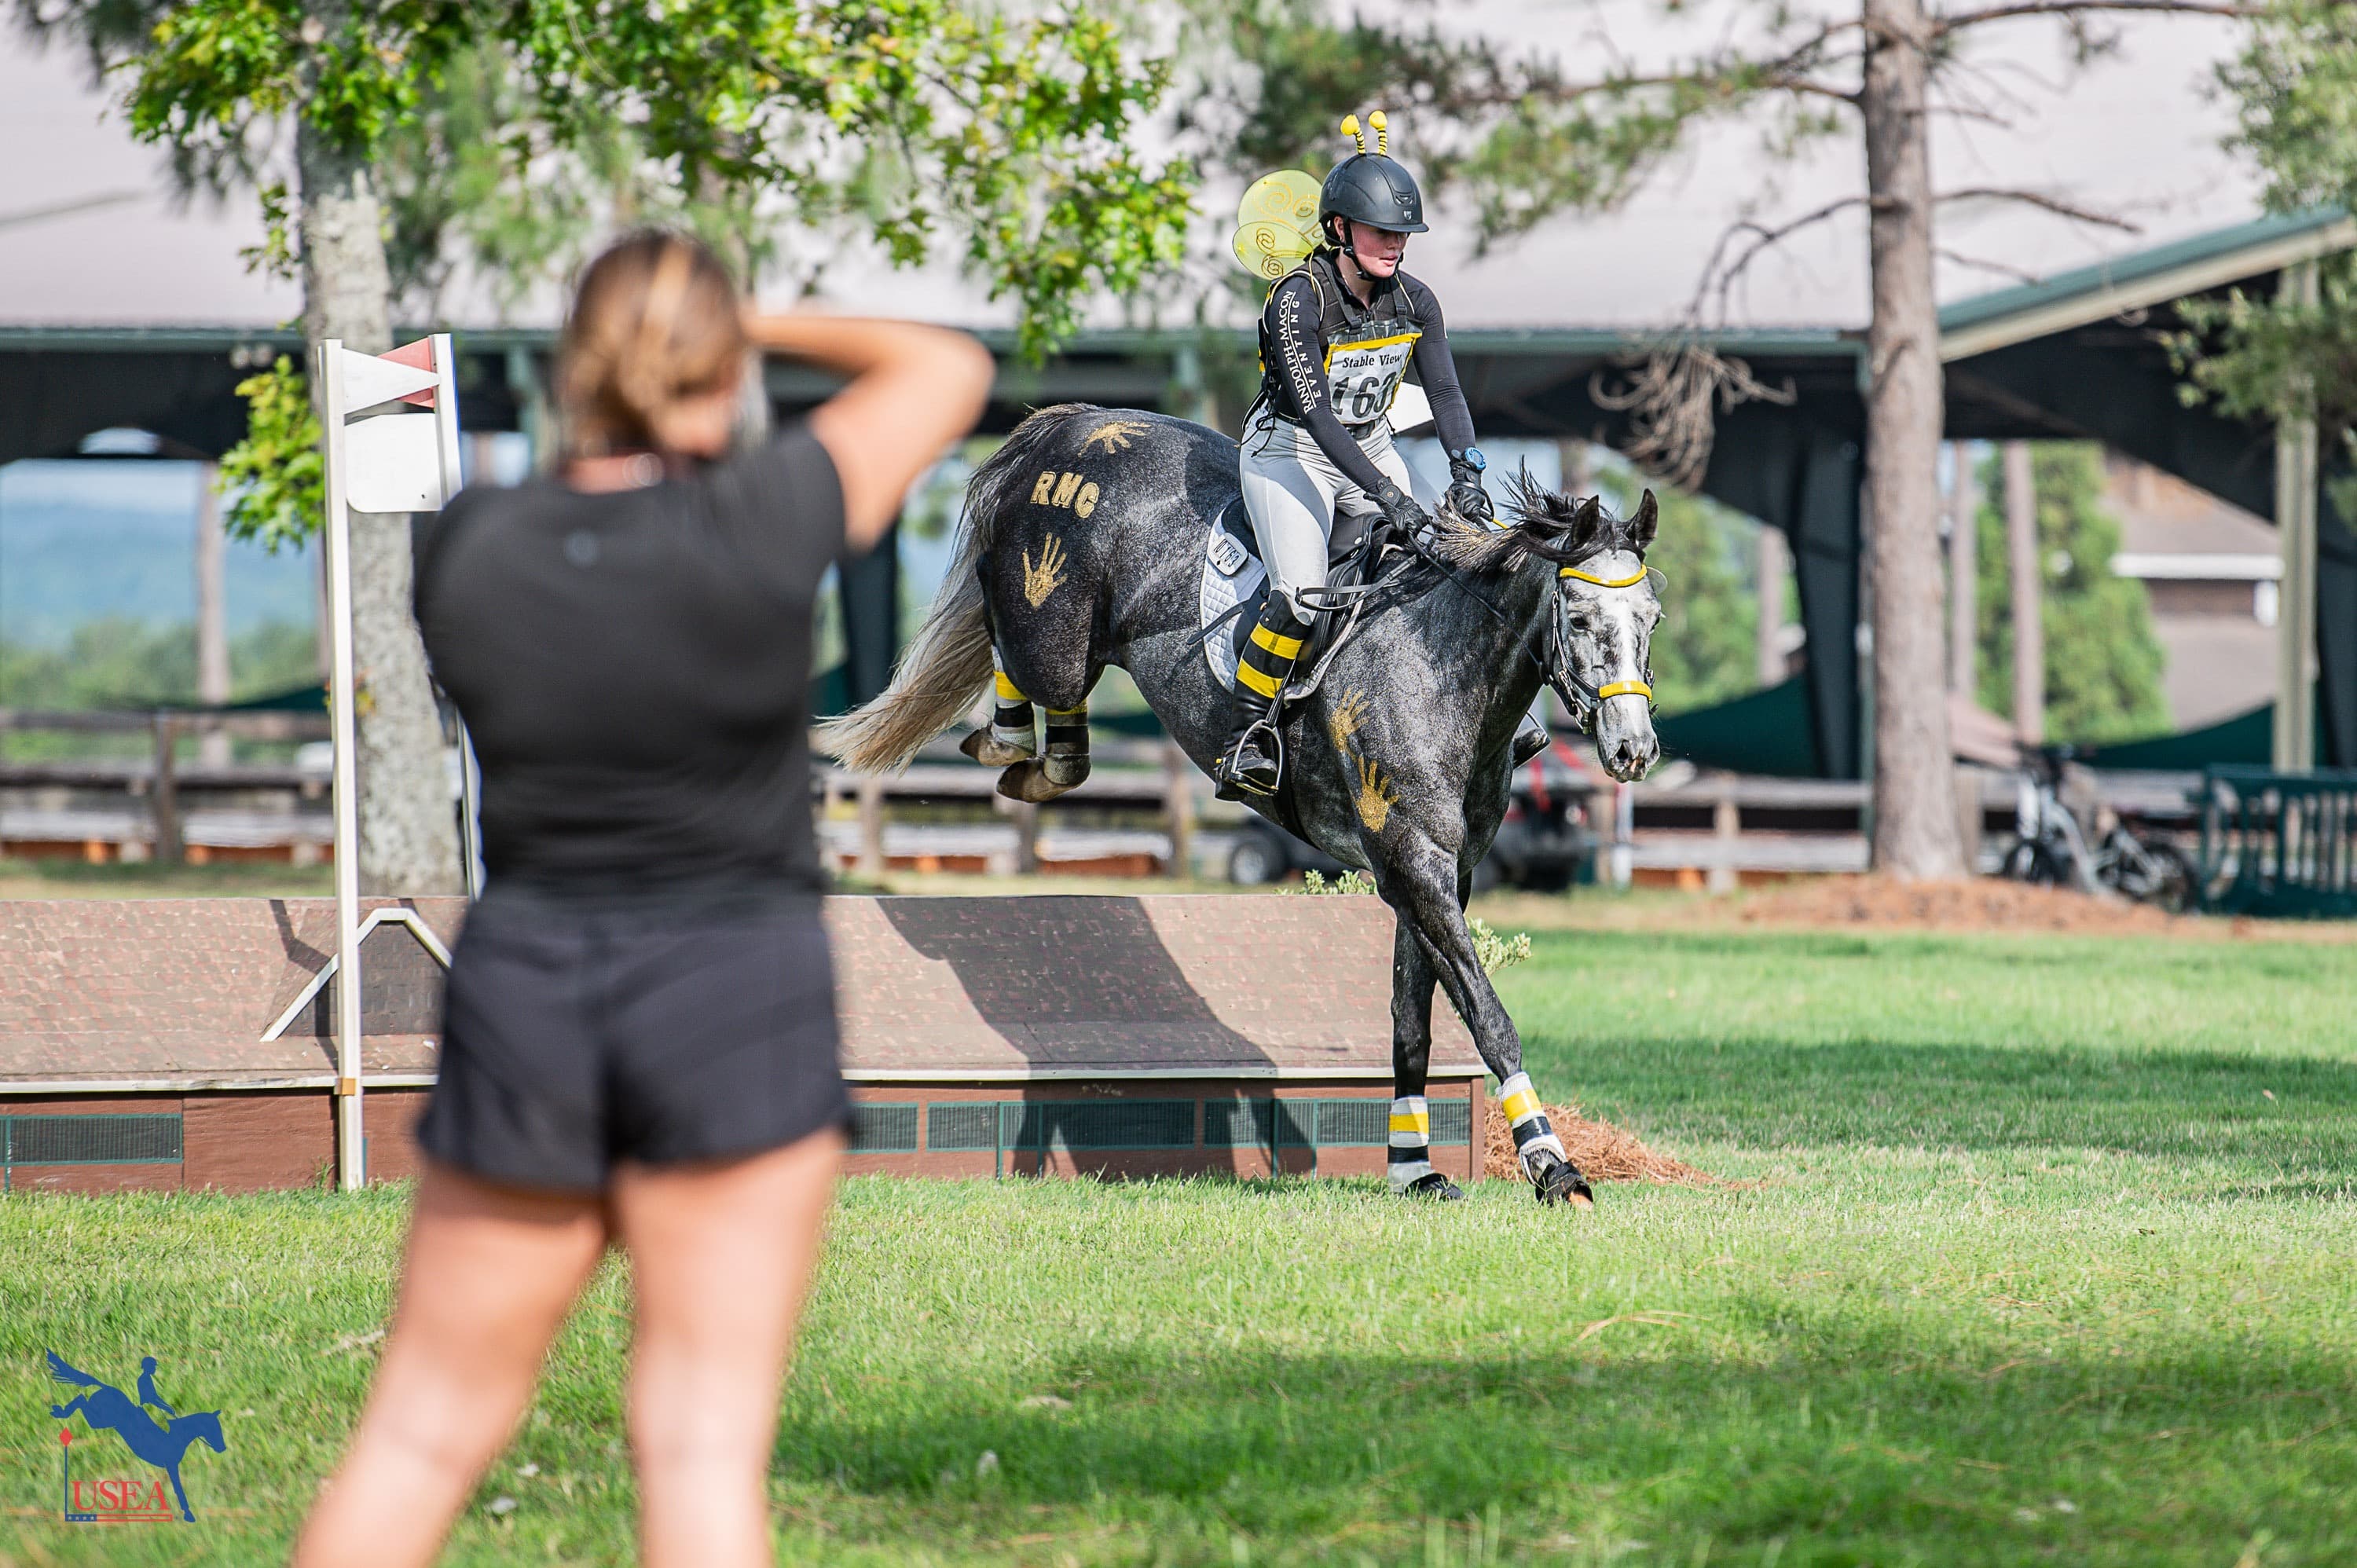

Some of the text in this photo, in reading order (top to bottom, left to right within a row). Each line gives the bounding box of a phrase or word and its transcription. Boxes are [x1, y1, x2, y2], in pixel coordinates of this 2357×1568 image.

[1279, 291, 1314, 415] RANDOLPH-MACON
[1291, 300, 1321, 399] EVENTING
[1342, 354, 1402, 368] Stable View
[1030, 471, 1100, 518] RMC
